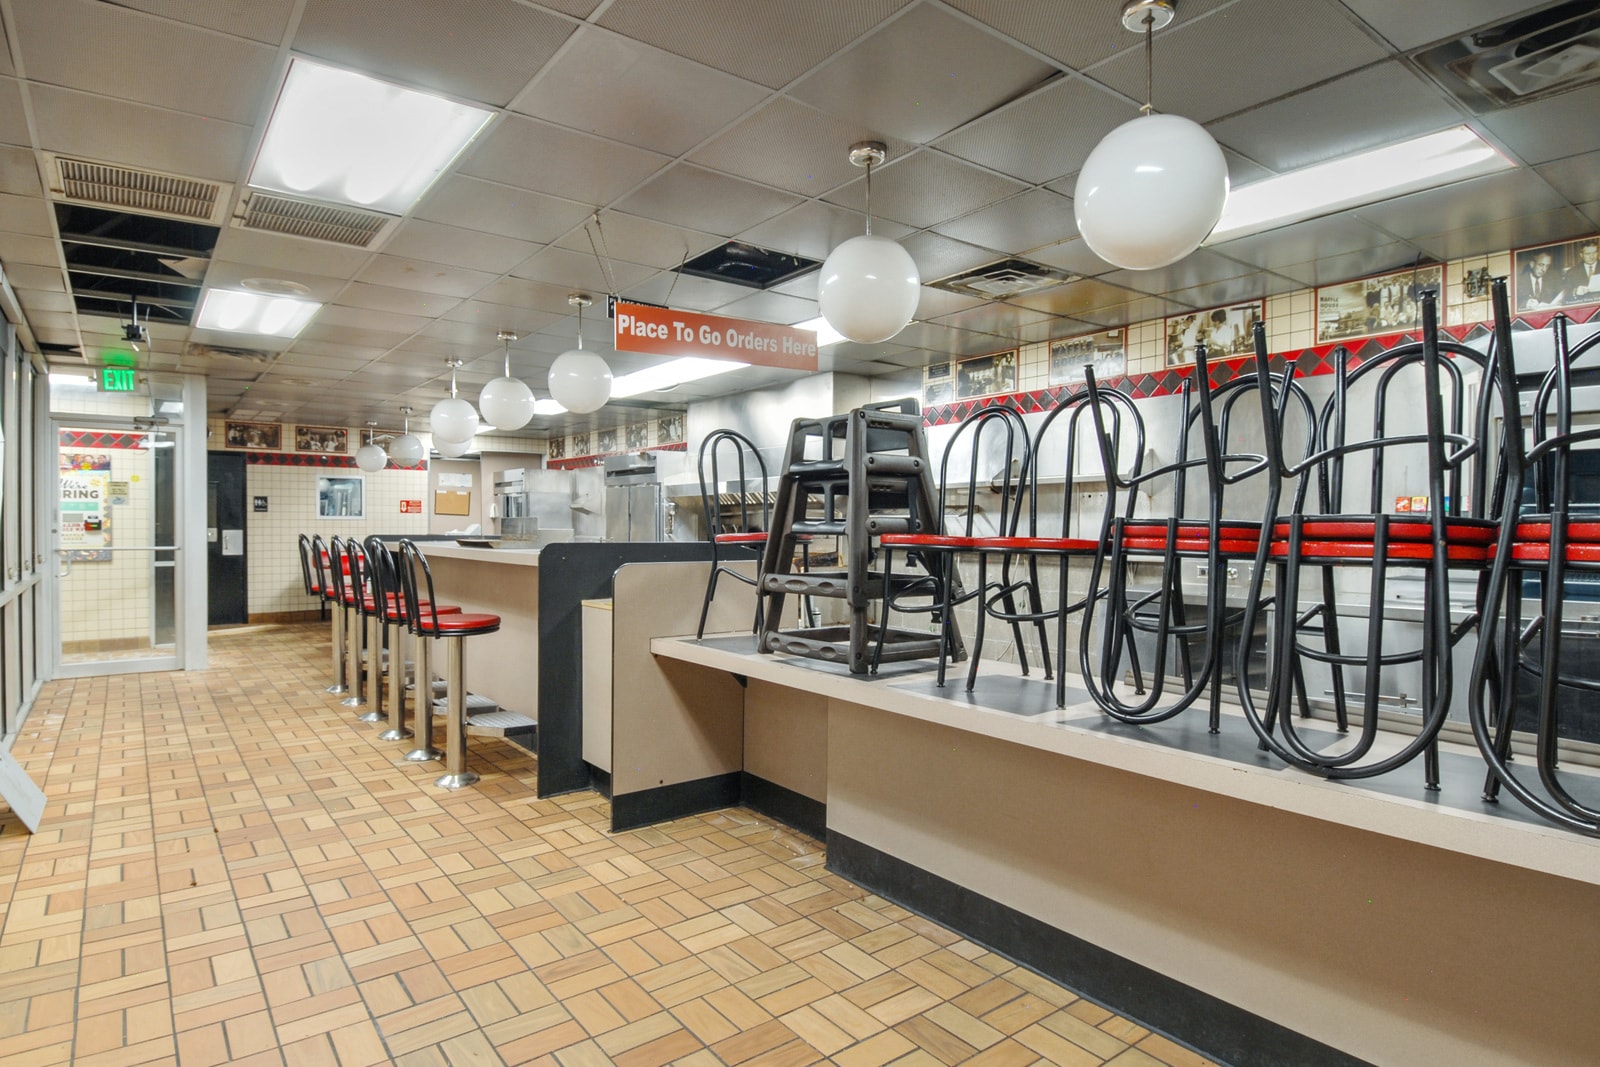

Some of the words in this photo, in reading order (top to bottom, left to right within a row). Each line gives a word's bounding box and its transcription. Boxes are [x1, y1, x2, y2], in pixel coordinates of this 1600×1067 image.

[618, 313, 668, 339] Place
[673, 321, 694, 342] To
[699, 325, 721, 346] Go
[726, 328, 778, 353] Orders
[782, 336, 816, 357] Here
[103, 369, 135, 391] EXIT
[63, 490, 99, 499] RING
